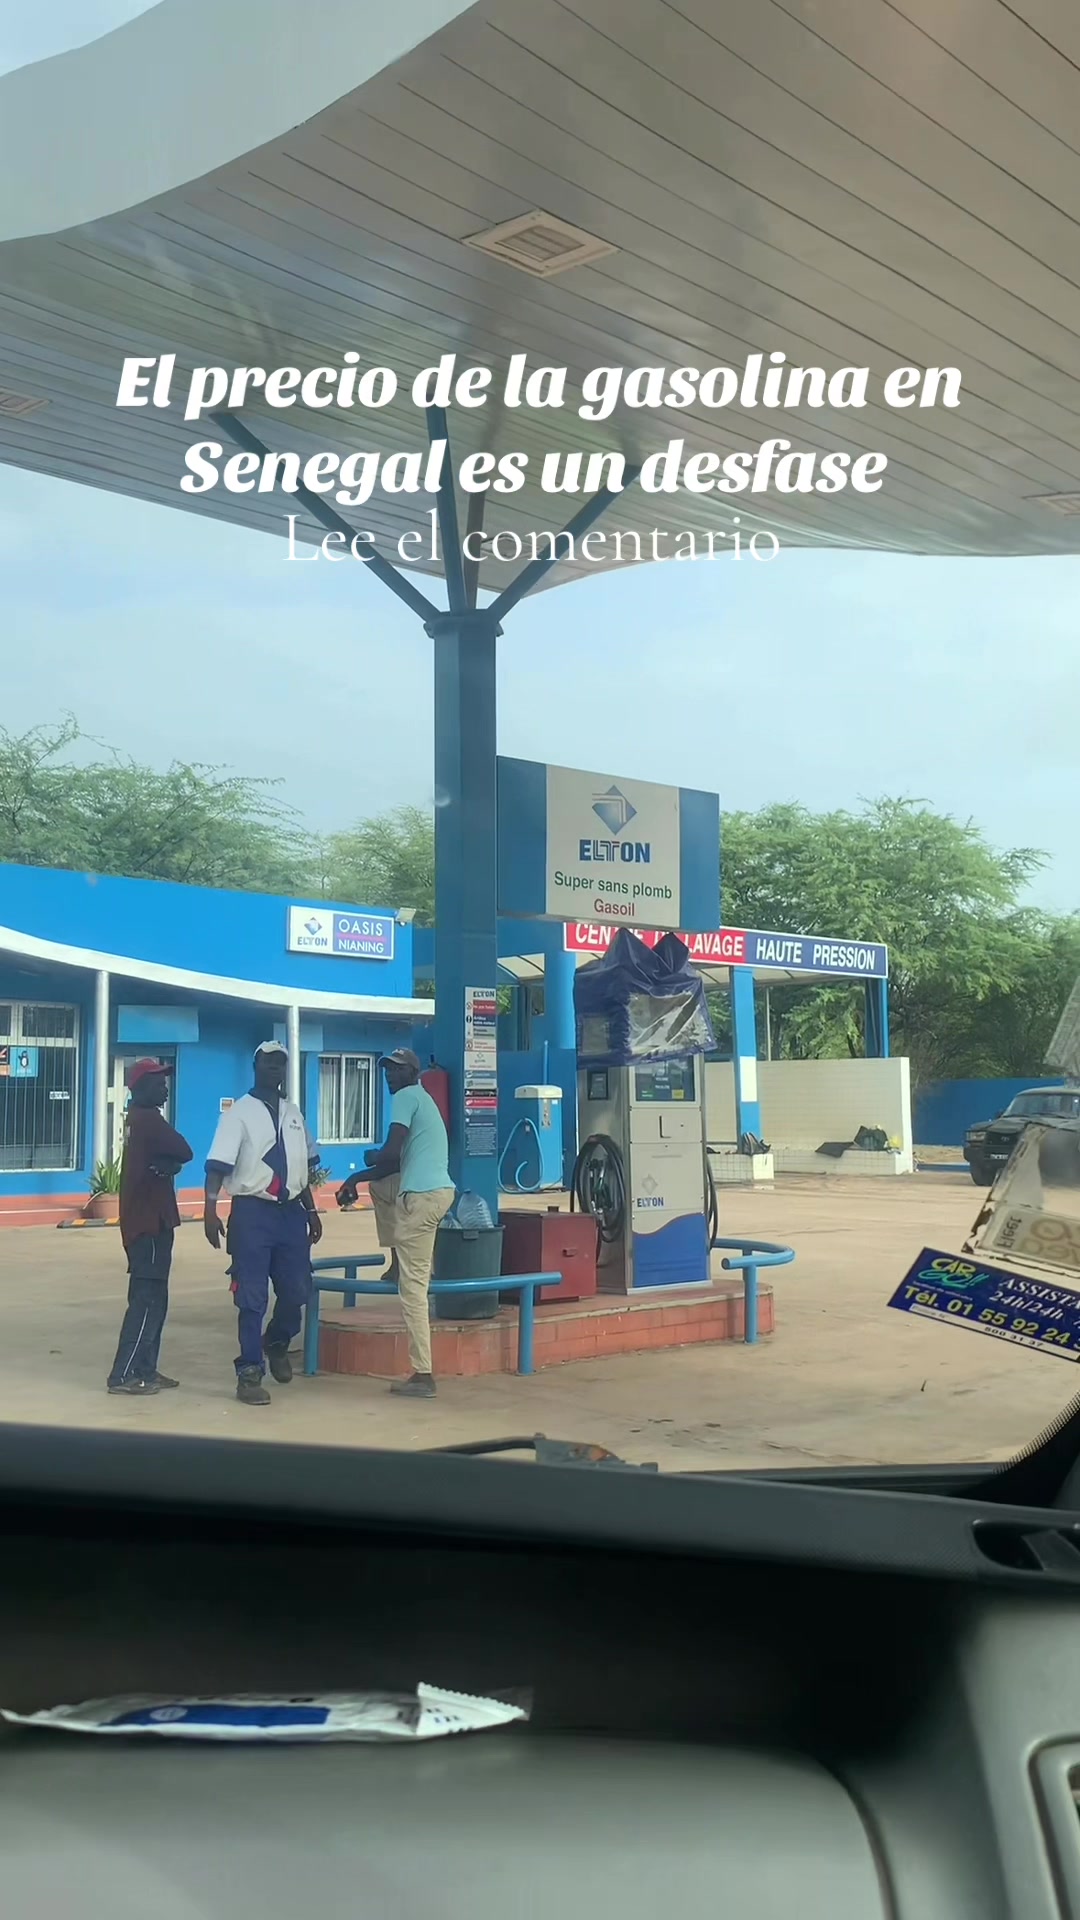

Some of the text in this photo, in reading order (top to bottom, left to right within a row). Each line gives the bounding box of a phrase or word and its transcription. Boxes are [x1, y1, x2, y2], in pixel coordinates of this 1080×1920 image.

[579, 839, 651, 863] ELTON
[554, 871, 672, 899] Super sans plomb
[594, 898, 635, 916] Gasoil
[338, 919, 383, 937] OASIS
[297, 936, 328, 947] ELTON
[338, 939, 384, 954] NIANING
[756, 938, 802, 964] HAUTE
[812, 944, 875, 970] PRESSION
[637, 1197, 664, 1208] ELTON
[931, 1258, 977, 1278] CAR
[905, 1285, 939, 1307] Tél.
[947, 1299, 974, 1316] 01
[978, 1308, 1008, 1326] 55
[1010, 1318, 1040, 1336] 92
[1041, 1328, 1071, 1345] 24
[989, 1290, 1065, 1320] 24h/24h
